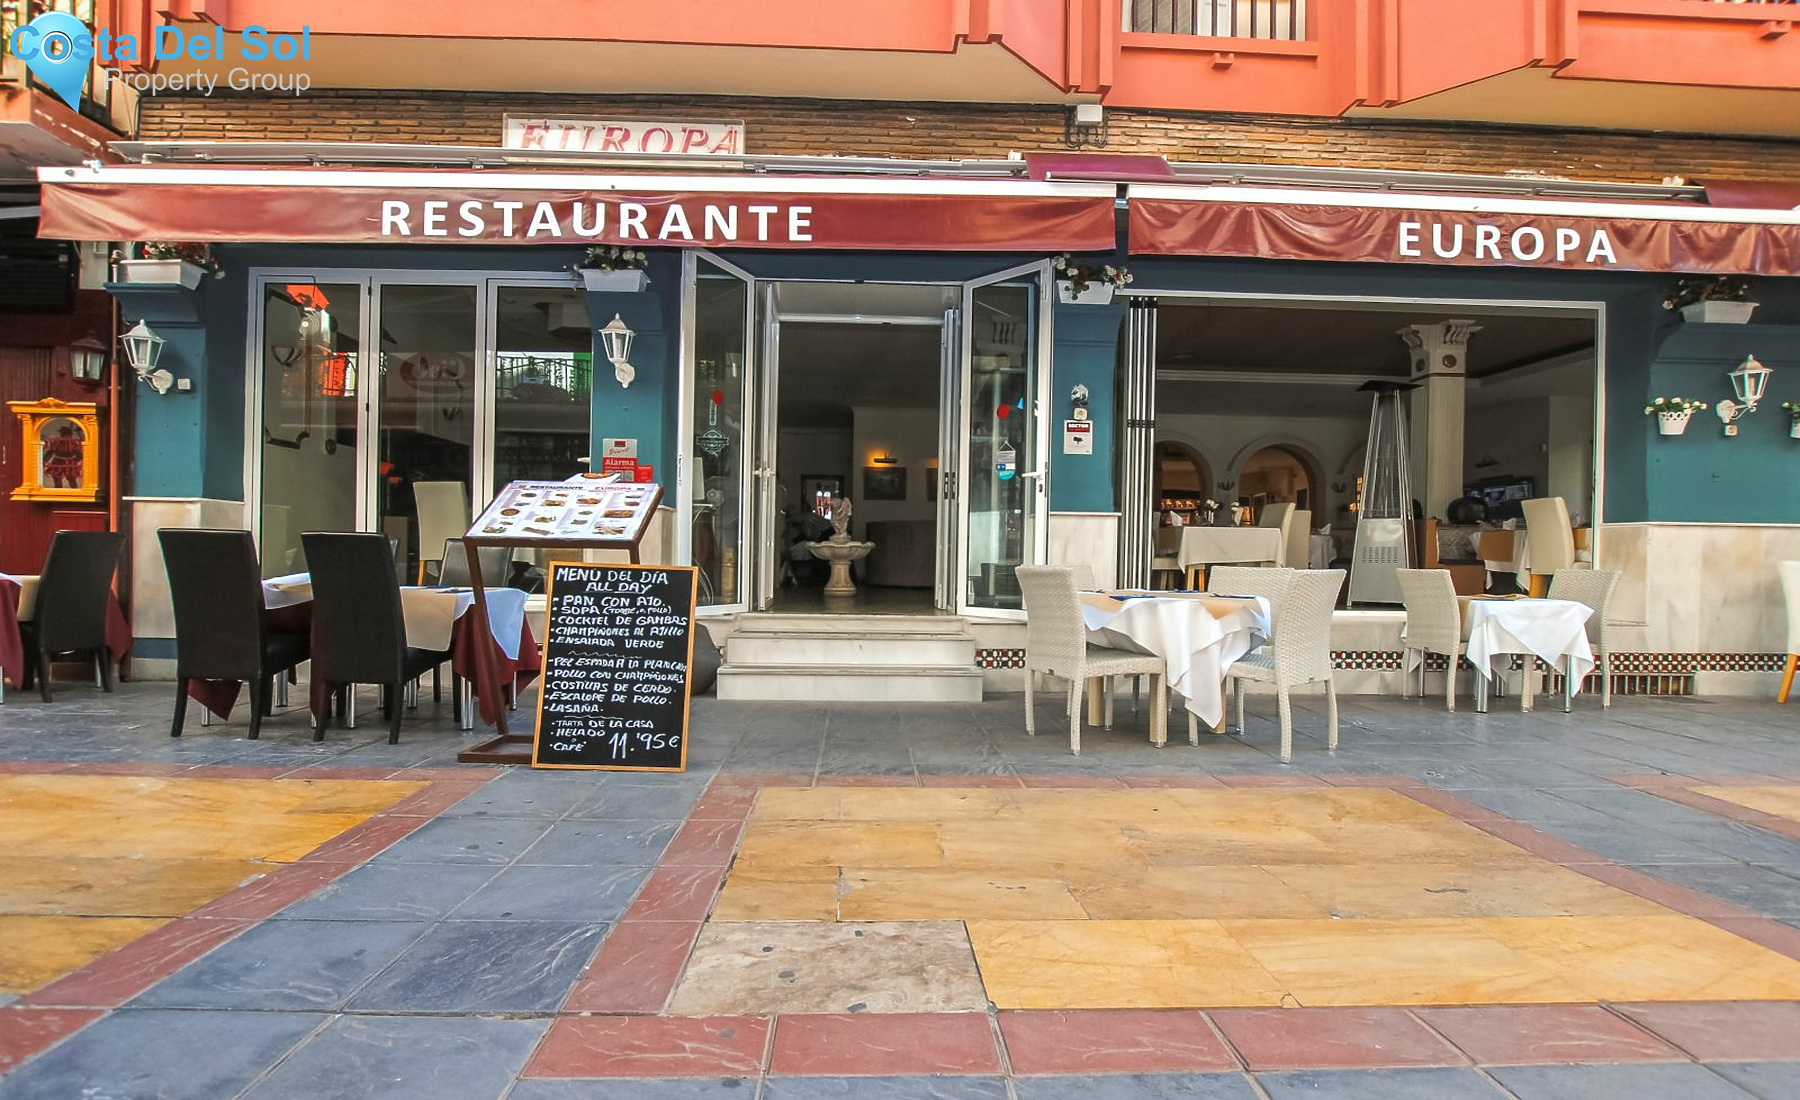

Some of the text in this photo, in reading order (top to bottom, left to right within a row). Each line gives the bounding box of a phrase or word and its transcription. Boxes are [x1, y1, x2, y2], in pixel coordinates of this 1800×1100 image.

[519, 120, 738, 154] EUROPA
[381, 200, 813, 241] RESTAURANTE
[1399, 221, 1617, 264] EUROPA
[607, 570, 633, 582] DEL
[585, 582, 652, 594] ALL DAY
[563, 595, 594, 606] PAN
[601, 596, 630, 607] CON
[561, 605, 600, 615] SOPA
[557, 615, 689, 626] COCKTEL DE GAMBAS
[633, 627, 645, 636] AL
[555, 636, 666, 649] ENSALADA VERDE
[575, 656, 614, 669] ESPADA
[615, 658, 625, 669] A
[628, 659, 640, 669] LA
[554, 669, 587, 679] POLLO
[590, 670, 612, 680] CON
[613, 683, 629, 692] DE
[549, 691, 606, 703] ESCALOPE
[611, 693, 628, 703] DE
[588, 720, 605, 728] DE
[609, 720, 623, 729] LA
[625, 720, 654, 729] CASA
[556, 728, 606, 737] HELADO
